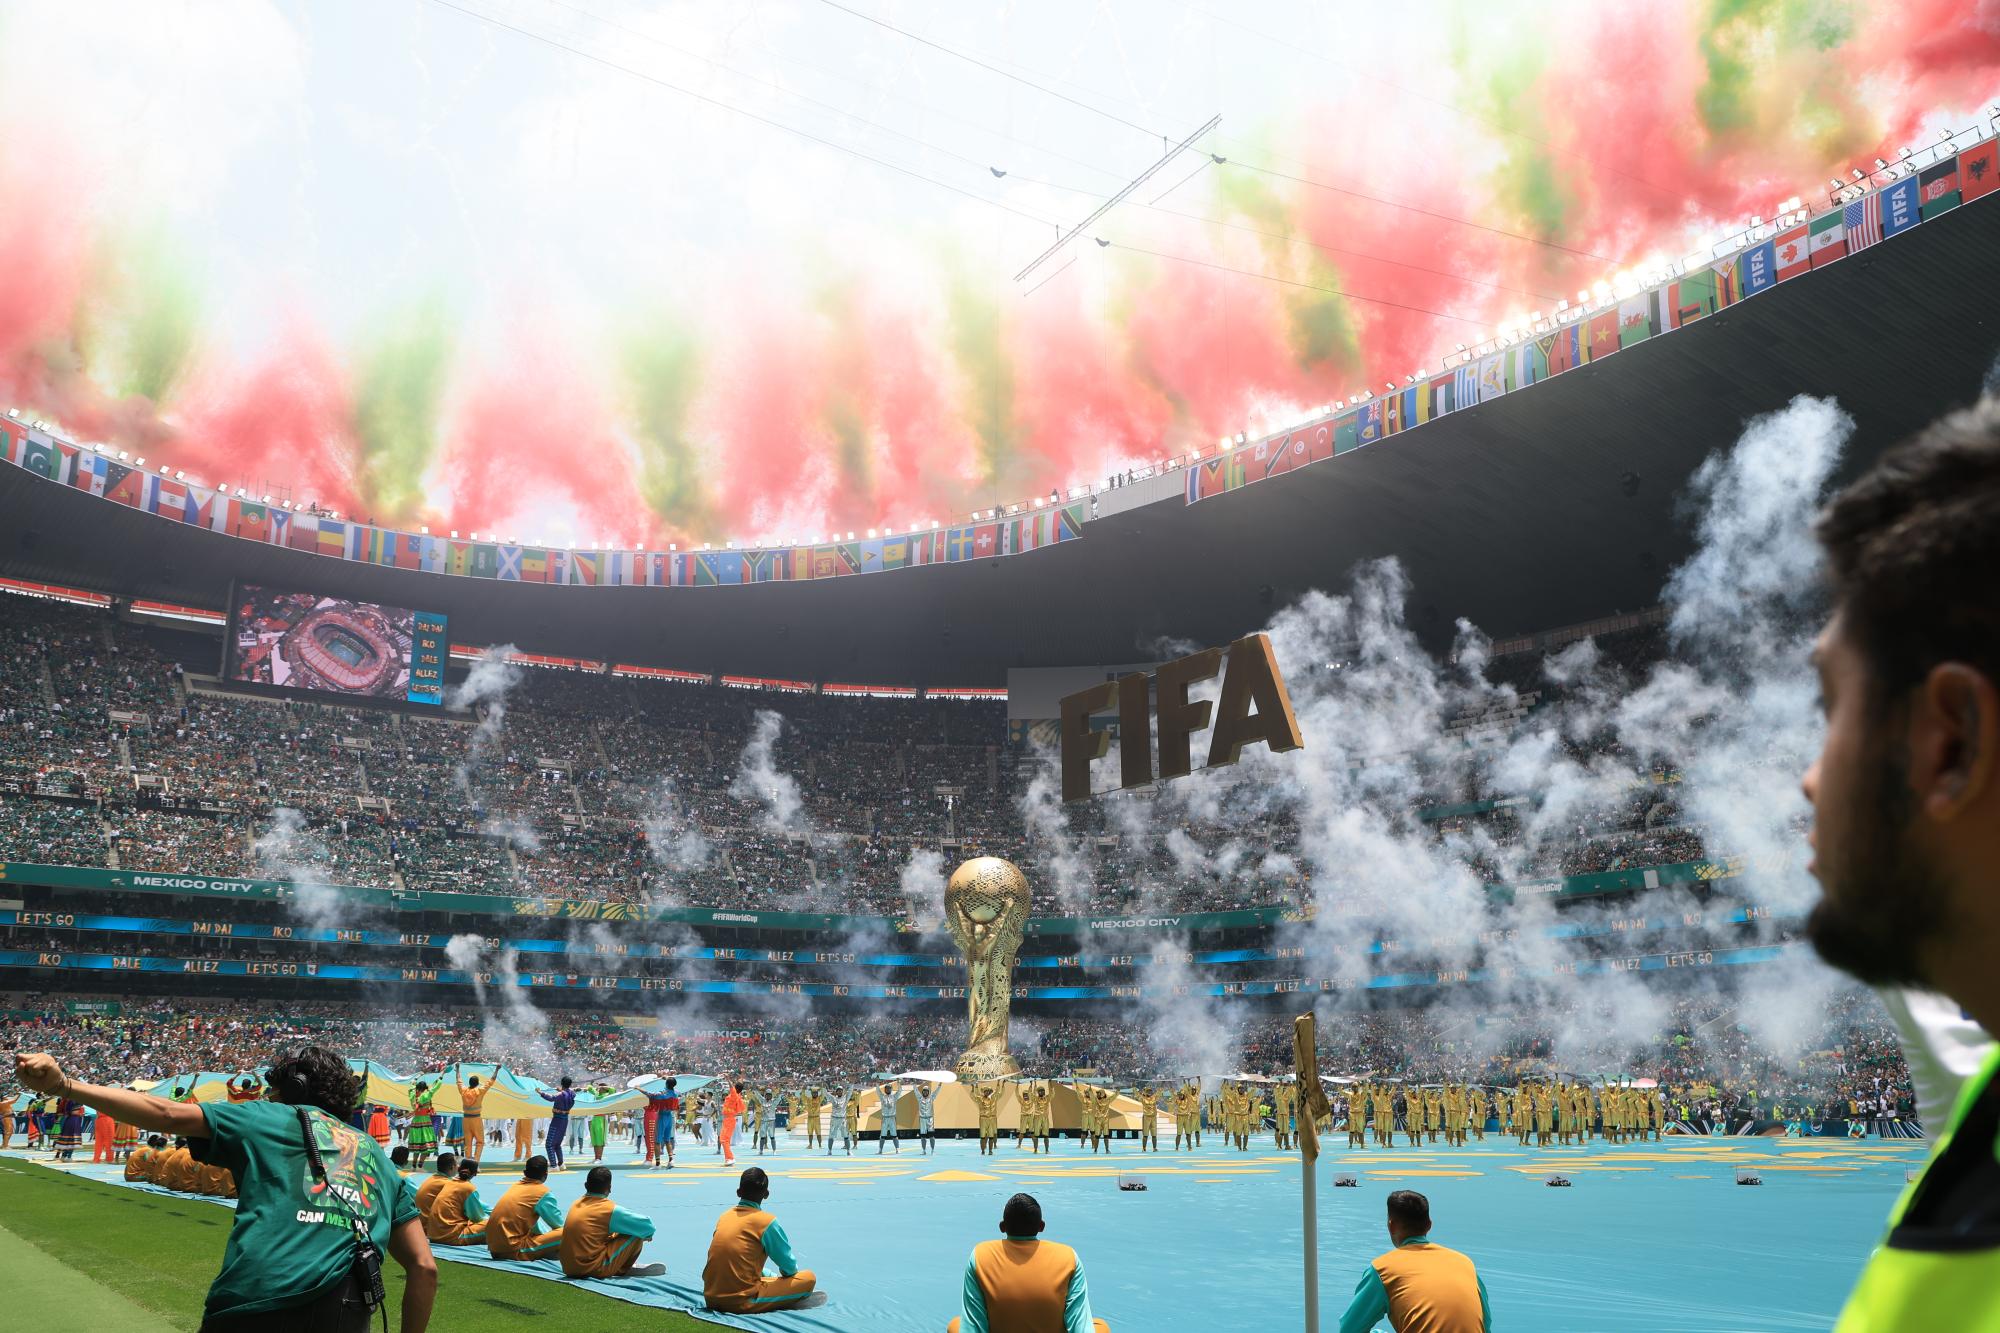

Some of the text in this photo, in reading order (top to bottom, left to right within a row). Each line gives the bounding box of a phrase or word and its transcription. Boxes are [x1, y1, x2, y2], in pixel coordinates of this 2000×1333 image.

[1892, 186, 1909, 227] FIFA
[1752, 249, 1765, 288] FIFA
[1060, 631, 1304, 803] FIFA
[134, 876, 253, 893] MEXICO CITY
[16, 911, 74, 926] LET'S GO
[712, 912, 758, 924] #FIFAWorldCup
[1683, 913, 1701, 925] IKO
[1746, 907, 1771, 921] DALE
[193, 922, 232, 935] DAI DAI
[1091, 917, 1180, 929] MEXICO CITY
[1630, 918, 1647, 929] DAI
[272, 926, 293, 938] IKO
[337, 930, 362, 942] DALE
[399, 934, 430, 945] ALLEZ
[38, 953, 61, 966] IKO
[714, 949, 736, 960] DALE
[767, 951, 794, 962] ALLEZ
[815, 952, 855, 963] LET'S GO
[1665, 952, 1713, 968] LET'S GO
[113, 957, 141, 969] DALE
[183, 961, 219, 973] ALLEZ
[1058, 957, 1080, 967] DALE
[1610, 958, 1640, 971] ALLEZ
[246, 962, 297, 975] LET'S GO
[402, 969, 437, 982] DAI DAI
[532, 975, 554, 986] DALE
[1437, 970, 1468, 982] DAI DAI
[589, 977, 617, 988] ALLEZ
[640, 978, 682, 990] LET'S GO
[771, 983, 801, 994] DAI DAI
[1274, 982, 1300, 993] ALLEZ
[832, 985, 849, 996] IKO
[885, 987, 907, 997] DALE
[938, 988, 965, 998] ALLEZ
[1014, 988, 1028, 998] GO
[1111, 986, 1141, 997] DAI DAI
[694, 1030, 750, 1039] MEXICO
[326, 1185, 361, 1204] FIFA
[297, 1210, 324, 1222] CAN
[326, 1213, 351, 1229] MEX
